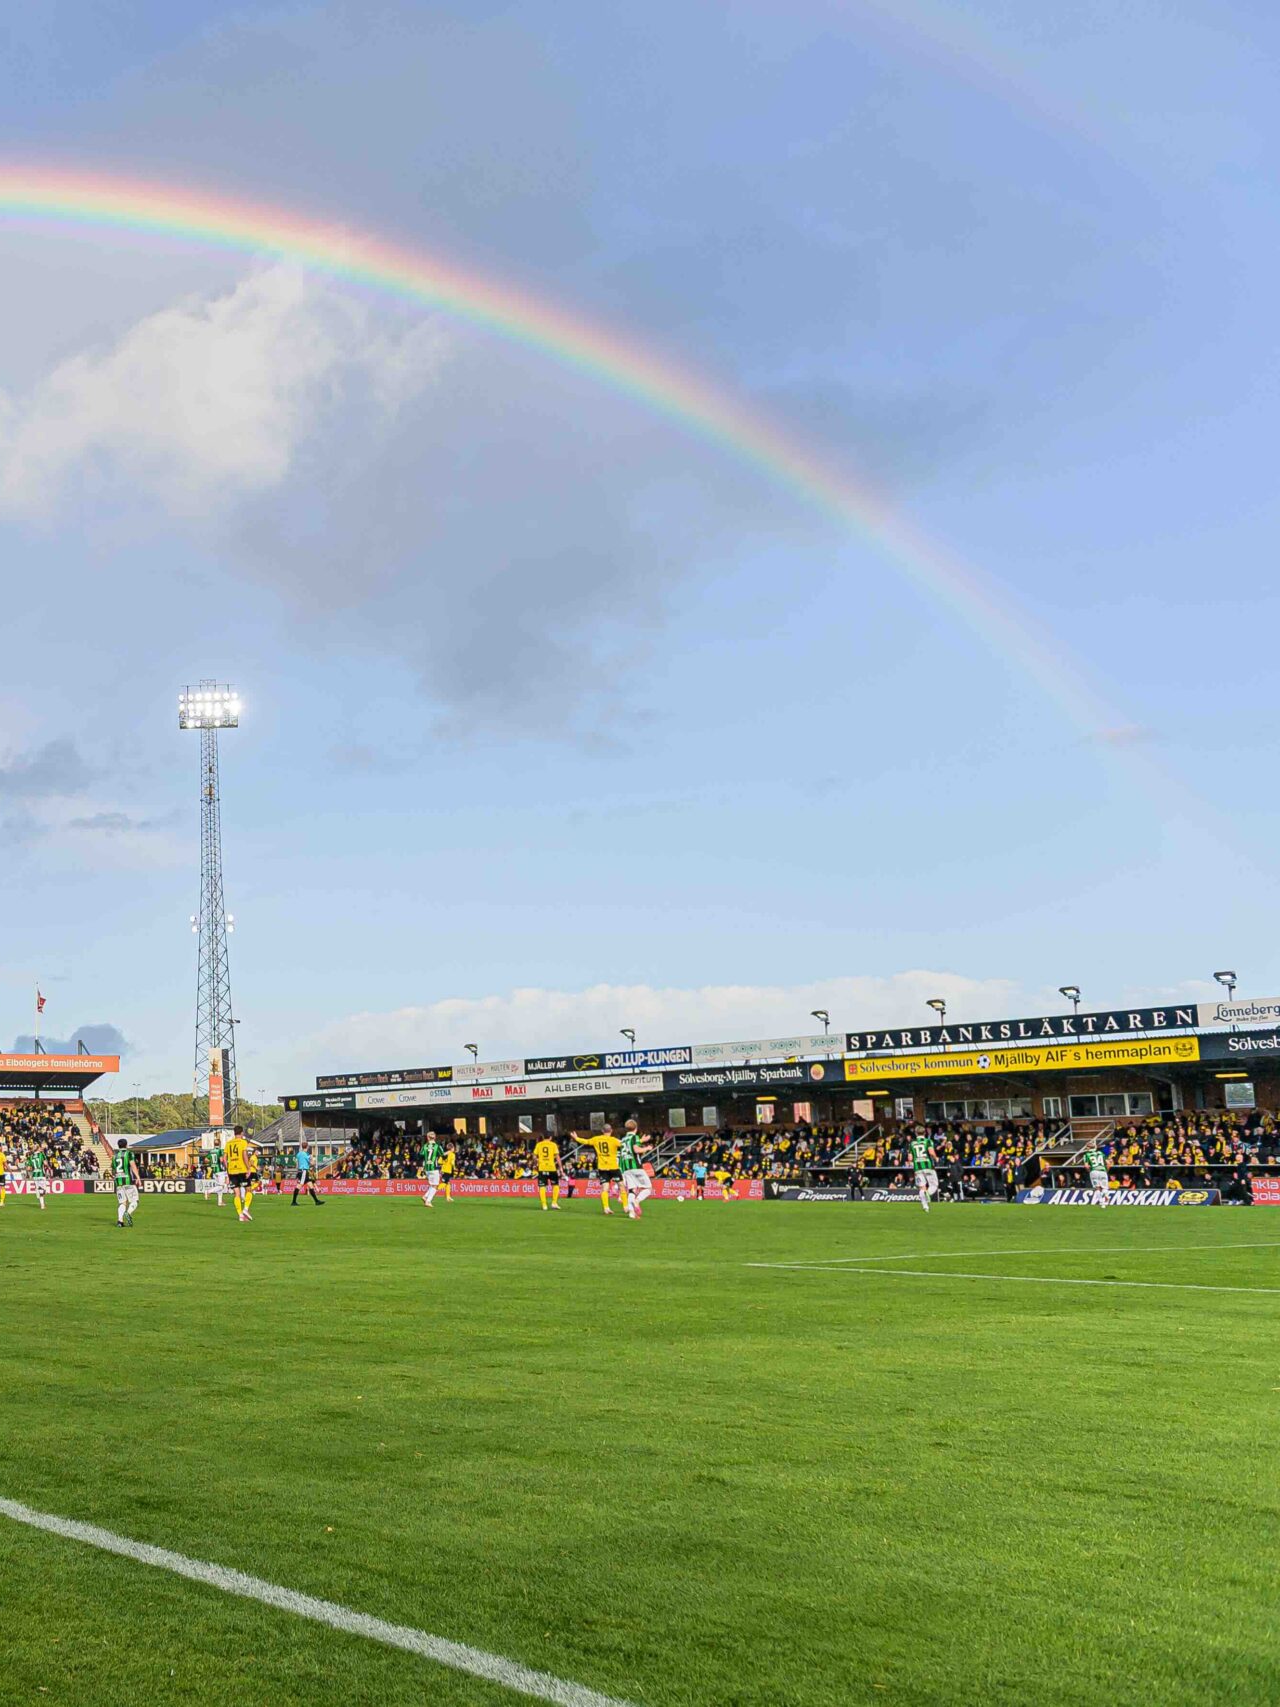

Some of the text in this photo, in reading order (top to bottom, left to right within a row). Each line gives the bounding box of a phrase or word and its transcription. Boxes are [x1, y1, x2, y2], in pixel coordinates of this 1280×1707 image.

[851, 1009, 1193, 1049] SPARBANKSLÄKTAREN
[605, 1049, 689, 1068] ROLLUP-KUNGEN
[859, 1060, 921, 1074] Sölvesborgs
[924, 1056, 973, 1069] kommun
[994, 1050, 1041, 1067] Mjällby
[1085, 1045, 1171, 1060] hemmaplan
[528, 1060, 566, 1070] MJÄLLBY AIF
[438, 1070, 451, 1078] MAIF
[679, 1068, 803, 1084] Sölvesborg-Mjällby Sparbank
[621, 1076, 661, 1085] meritum
[544, 1081, 611, 1093] AHLBERG BIL
[229, 1144, 238, 1157] 14
[542, 1147, 549, 1157] 9
[599, 1142, 609, 1153] 18
[914, 1145, 926, 1157] 12
[427, 1150, 433, 1160] 7
[116, 1159, 123, 1172] 2
[1090, 1156, 1104, 1166] 34
[521, 1183, 535, 1192] det
[1252, 1180, 1278, 1190] nkla
[871, 1192, 921, 1202] Börjesson
[1048, 1189, 1176, 1205] ALLSVENSKAN
